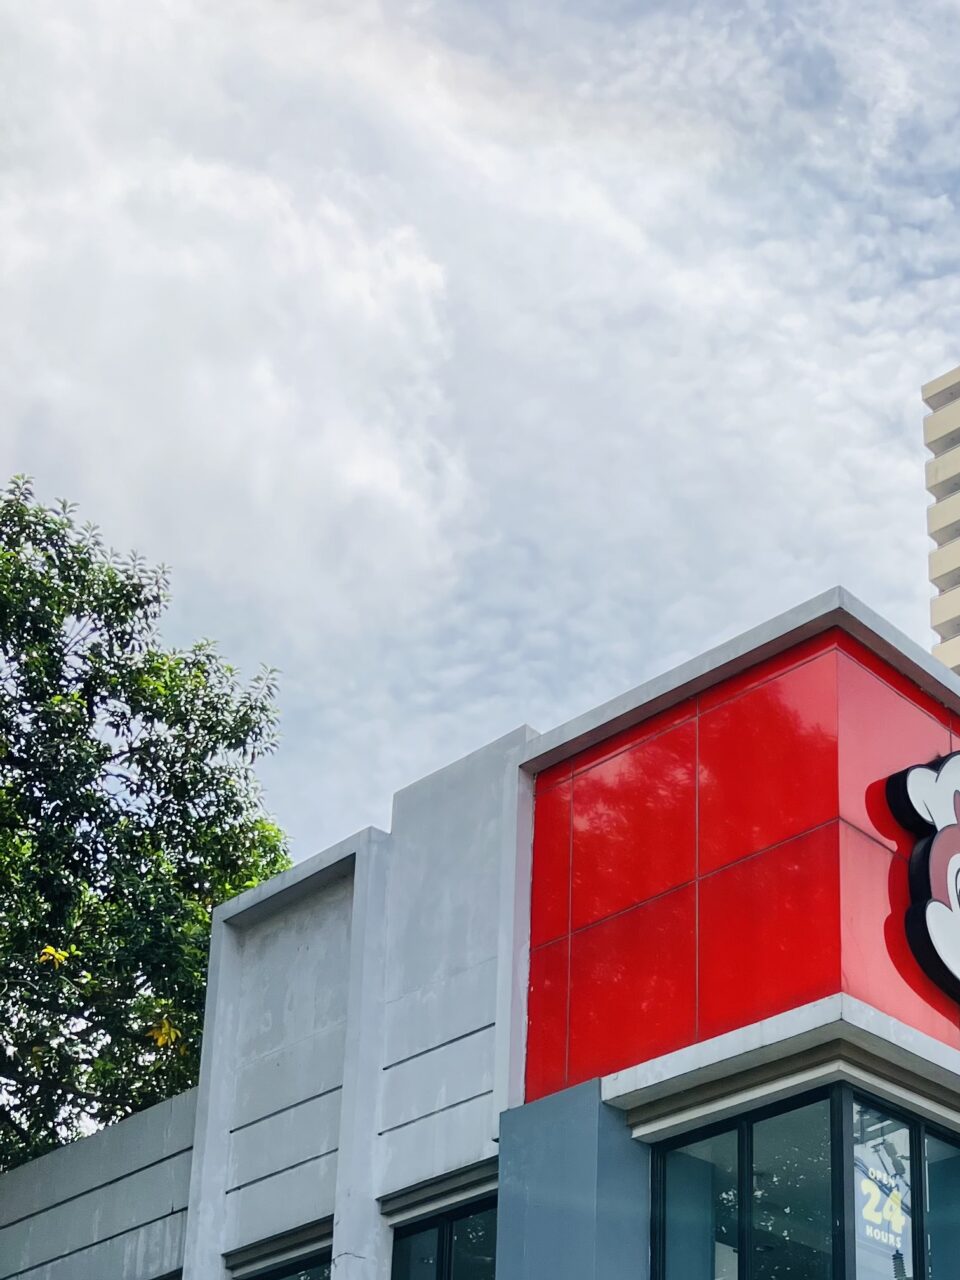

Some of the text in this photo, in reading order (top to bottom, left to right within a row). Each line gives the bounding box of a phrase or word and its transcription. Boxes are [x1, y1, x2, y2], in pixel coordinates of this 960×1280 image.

[868, 1167, 896, 1187] OPEN
[861, 1179, 905, 1234] 24
[866, 1225, 902, 1249] HOURS
